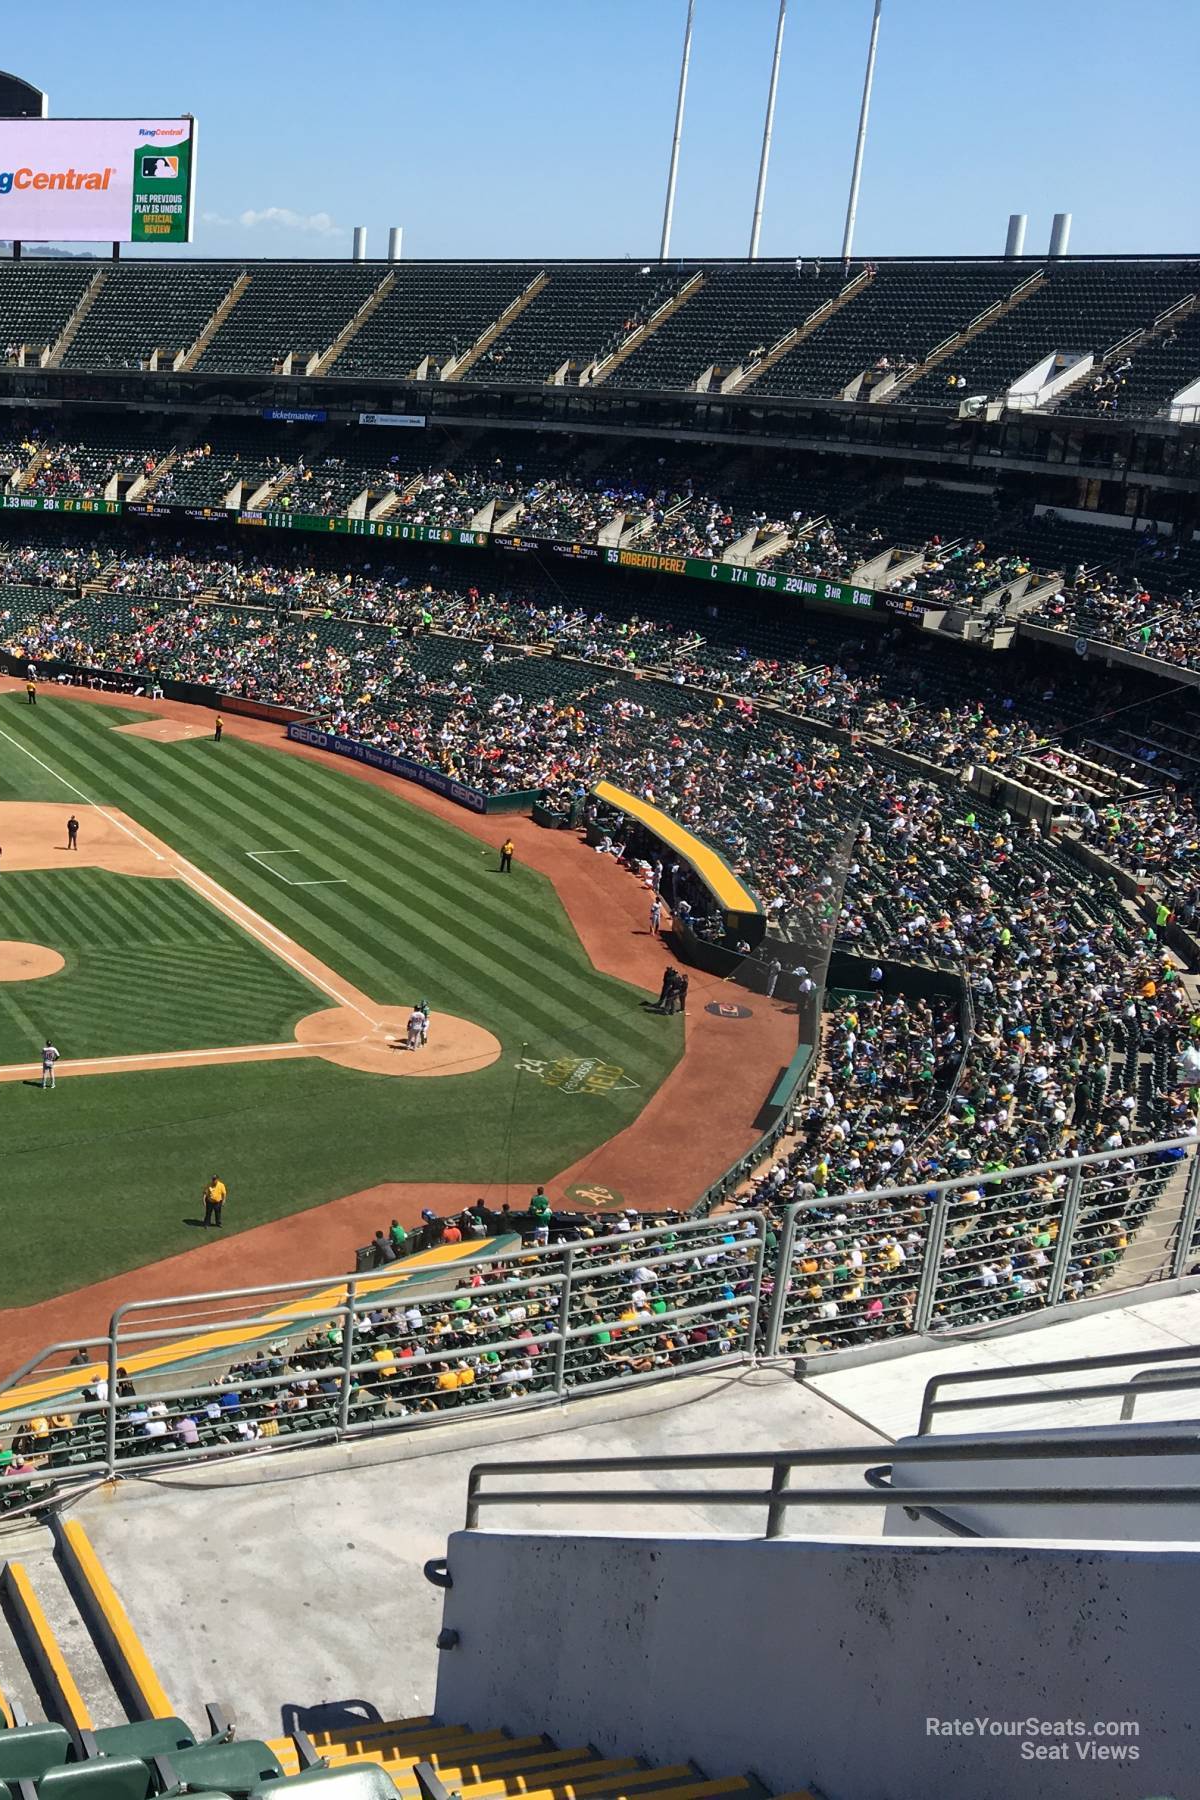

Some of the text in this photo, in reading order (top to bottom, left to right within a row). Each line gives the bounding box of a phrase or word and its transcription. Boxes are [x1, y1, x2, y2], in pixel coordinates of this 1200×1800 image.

[138, 128, 184, 138] RingCentral
[136, 194, 183, 203] THE PREVIOUS
[134, 204, 183, 214] PLAY IS UNDER
[143, 214, 173, 223] OFFICIAL
[144, 224, 171, 234] REVIEW
[272, 411, 316, 420] ticketmaster
[2, 496, 20, 508] 1.33
[20, 499, 37, 508] WHIP
[63, 500, 73, 510] 27
[428, 529, 441, 540] CLE
[460, 532, 475, 545] OAK
[607, 549, 619, 563] 55
[620, 551, 658, 569] ROBERTO
[659, 557, 687, 573] PEREZ
[710, 565, 717, 578] C
[731, 568, 742, 582] 17
[756, 572, 767, 587] 76
[767, 576, 777, 587] AB
[783, 577, 803, 593] .224
[803, 581, 817, 594] AVG
[824, 584, 831, 598] 3
[831, 587, 841, 599] HR
[853, 590, 859, 604] 8
[859, 593, 872, 606] RBI
[290, 727, 328, 747] GEICO
[334, 740, 352, 753] Over
[451, 783, 484, 810] GEICO
[514, 1057, 548, 1075] 24
